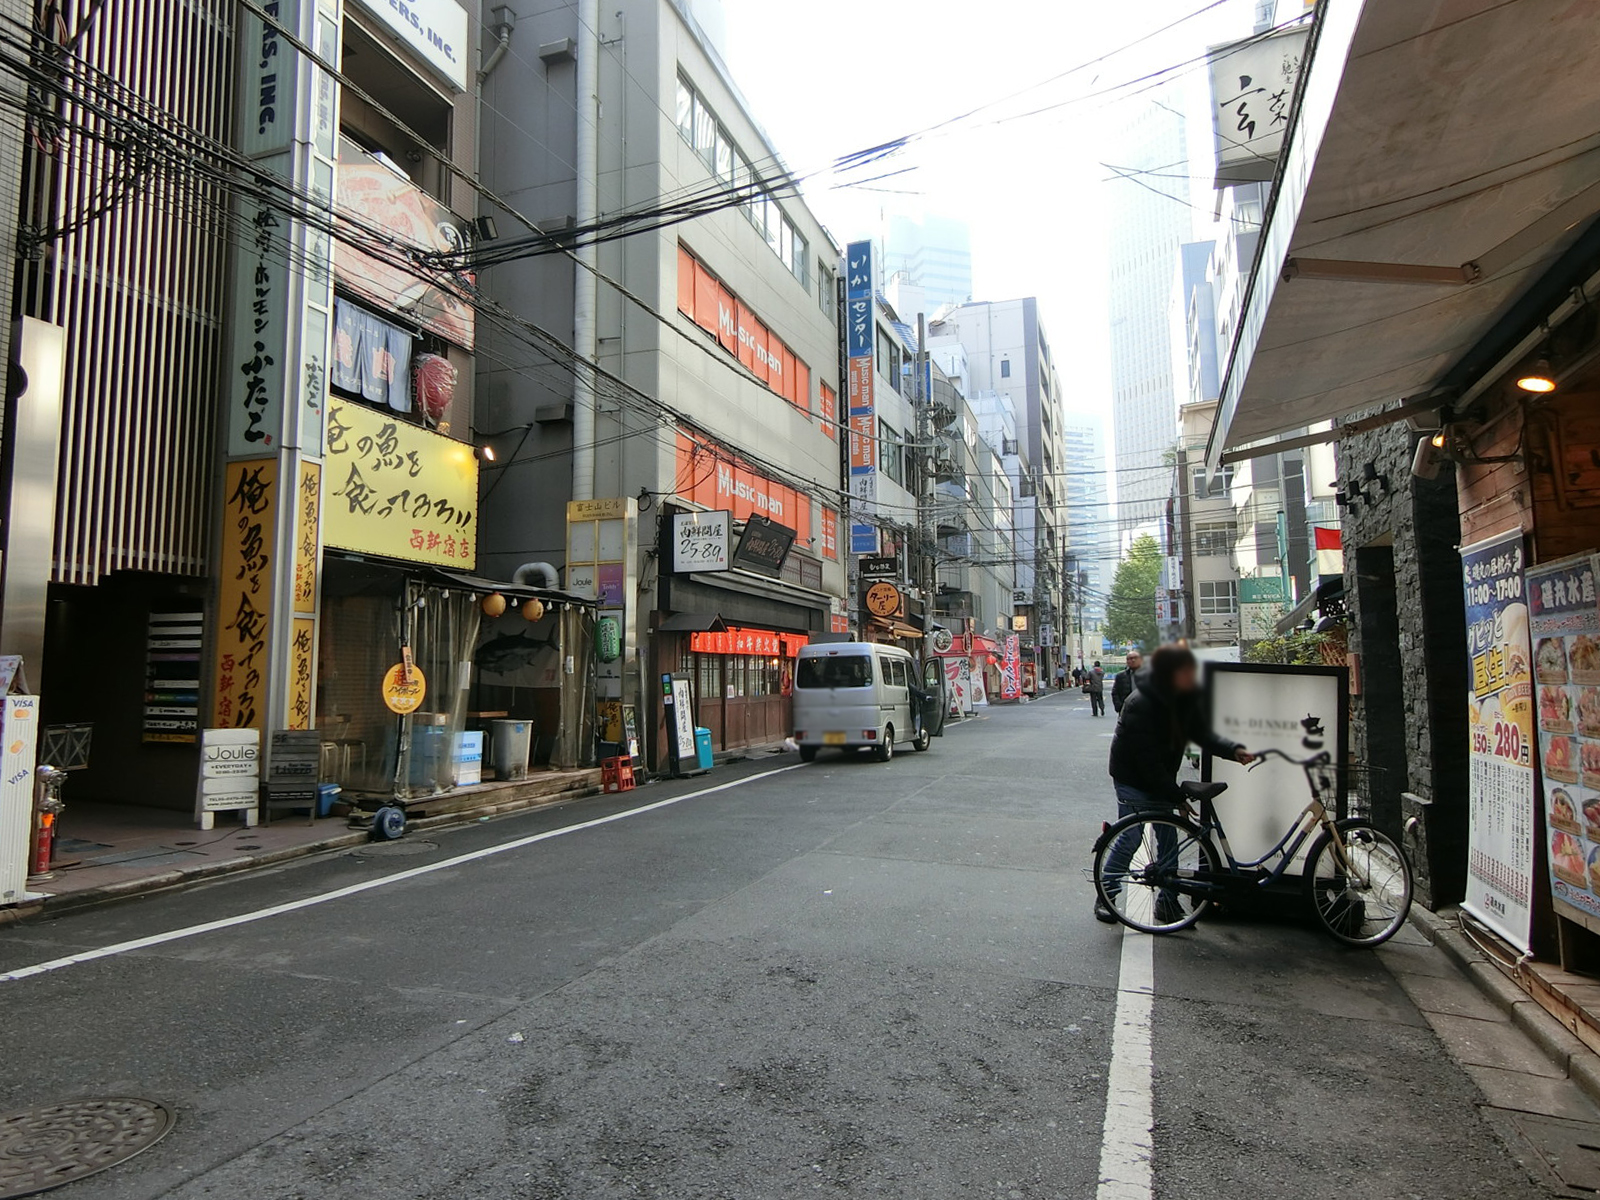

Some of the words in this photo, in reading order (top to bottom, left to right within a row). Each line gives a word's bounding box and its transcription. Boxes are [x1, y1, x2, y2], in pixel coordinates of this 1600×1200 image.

[427, 27, 456, 64] INC.
[259, 74, 277, 134] INC.
[851, 255, 868, 287] いか
[719, 301, 756, 350] Music
[757, 345, 782, 376] man
[852, 302, 867, 347] センター
[306, 355, 322, 408] ふたご
[857, 358, 871, 384] Music
[241, 341, 274, 443] ふたご
[858, 416, 872, 444] Music
[863, 445, 871, 465] man
[718, 464, 755, 502] Music
[757, 491, 783, 516] man
[410, 528, 470, 558] 西新宿店
[573, 578, 592, 586] Joule
[870, 592, 896, 603] ターリー
[12, 699, 34, 708] VISA
[208, 745, 256, 760] Joule
[1494, 721, 1519, 761] 280
[8, 769, 30, 785] VISA
